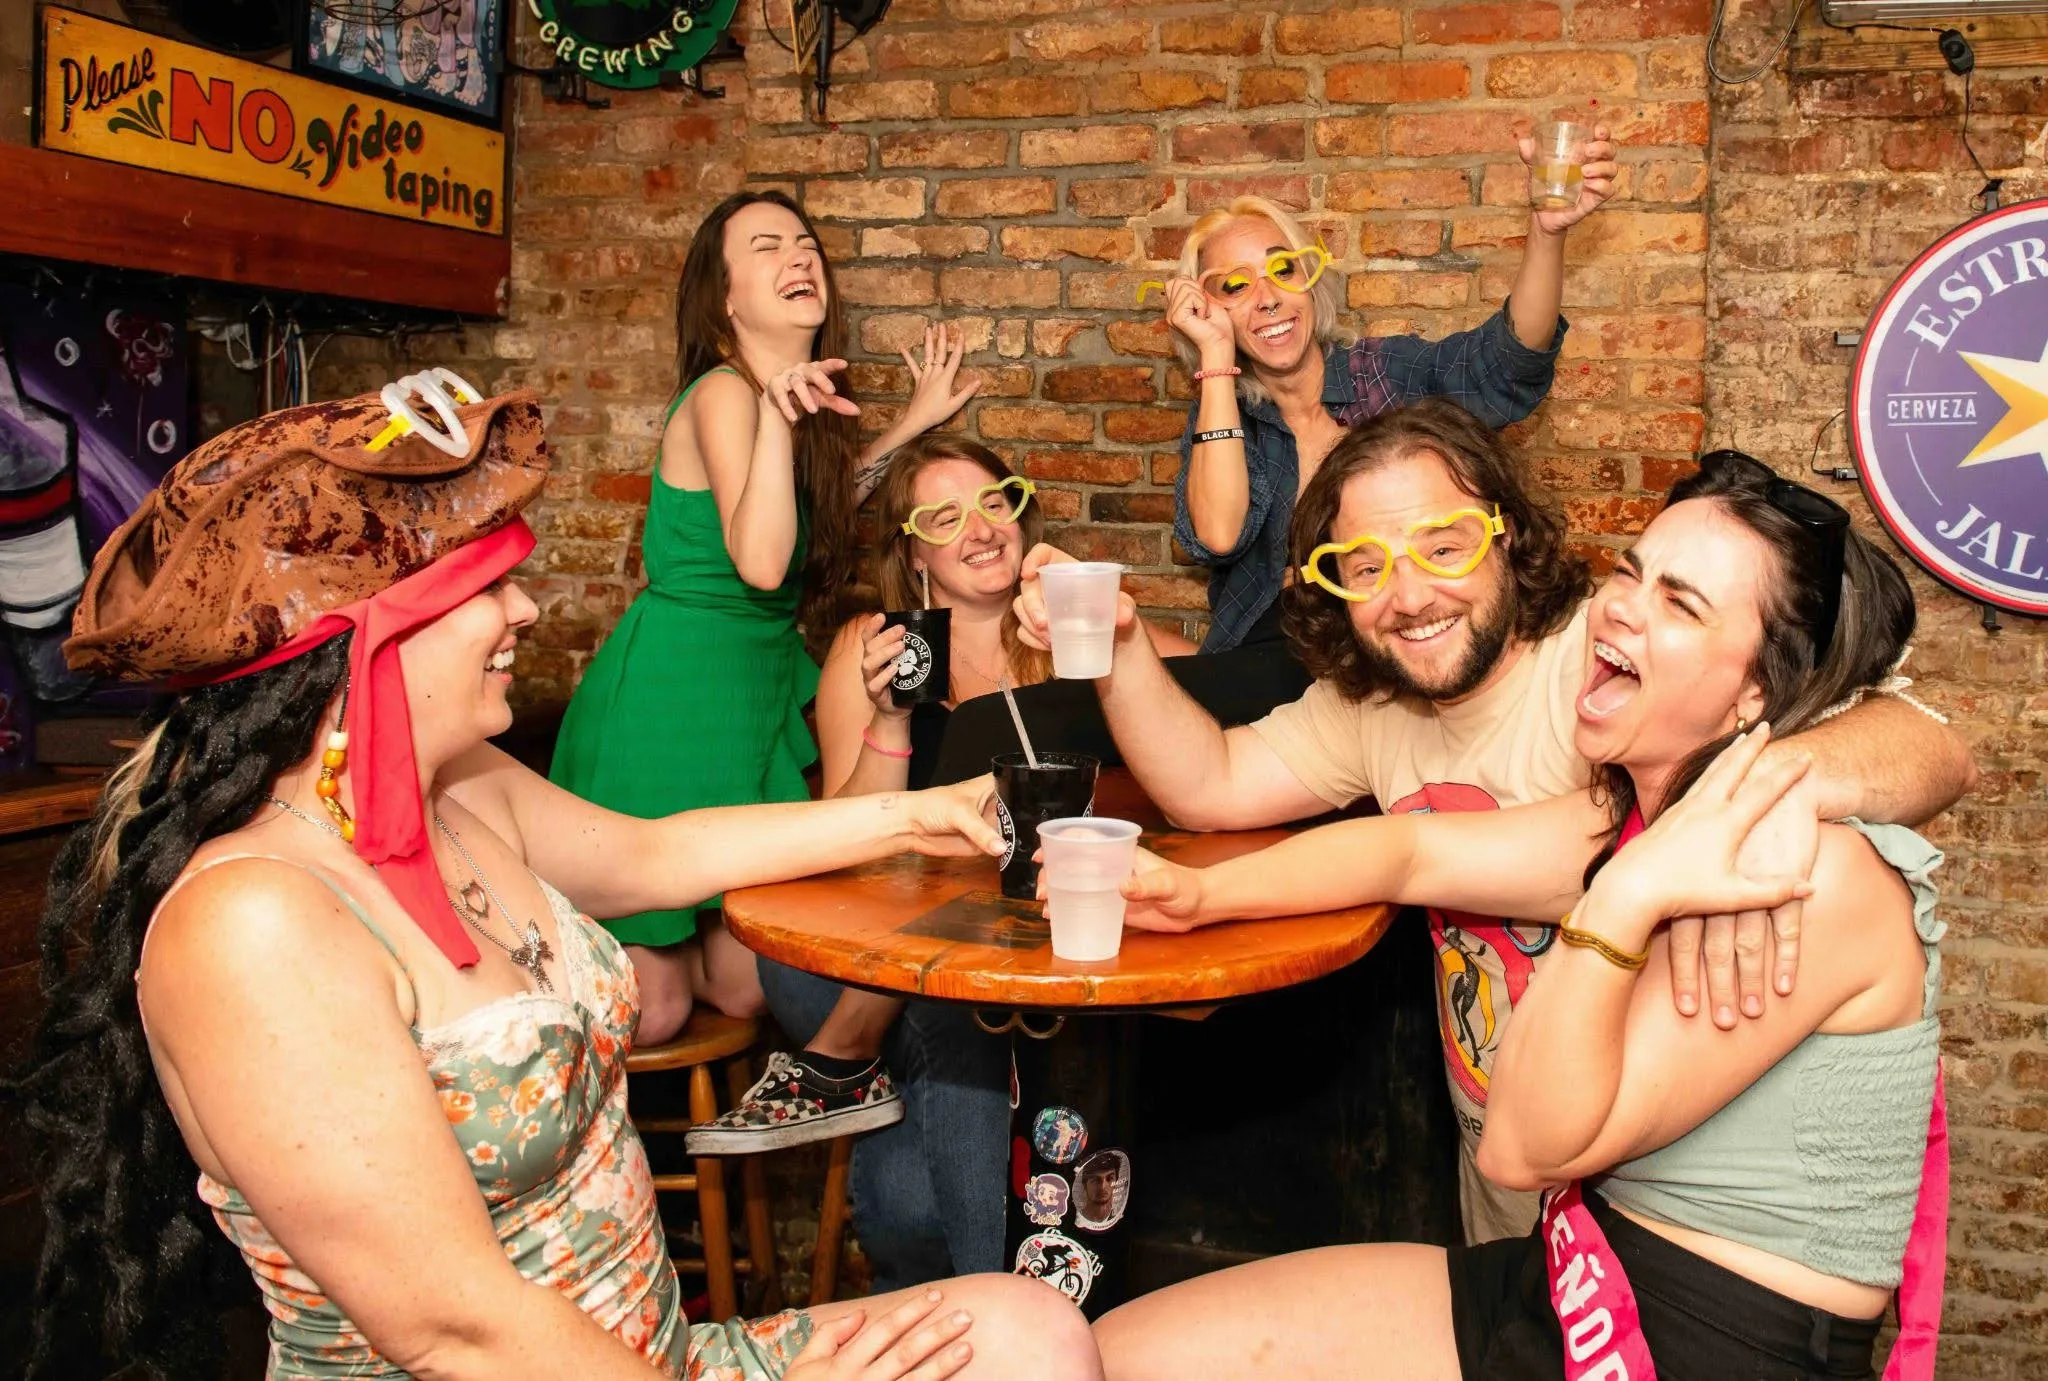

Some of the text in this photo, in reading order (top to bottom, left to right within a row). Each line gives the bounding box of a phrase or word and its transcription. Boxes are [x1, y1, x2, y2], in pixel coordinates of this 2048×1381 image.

[59, 47, 424, 188] Please NO Video
[383, 156, 495, 228] taping
[1201, 430, 1230, 441] BLACK
[1887, 399, 1978, 421] CERVEZA
[1935, 503, 2048, 580] JAL
